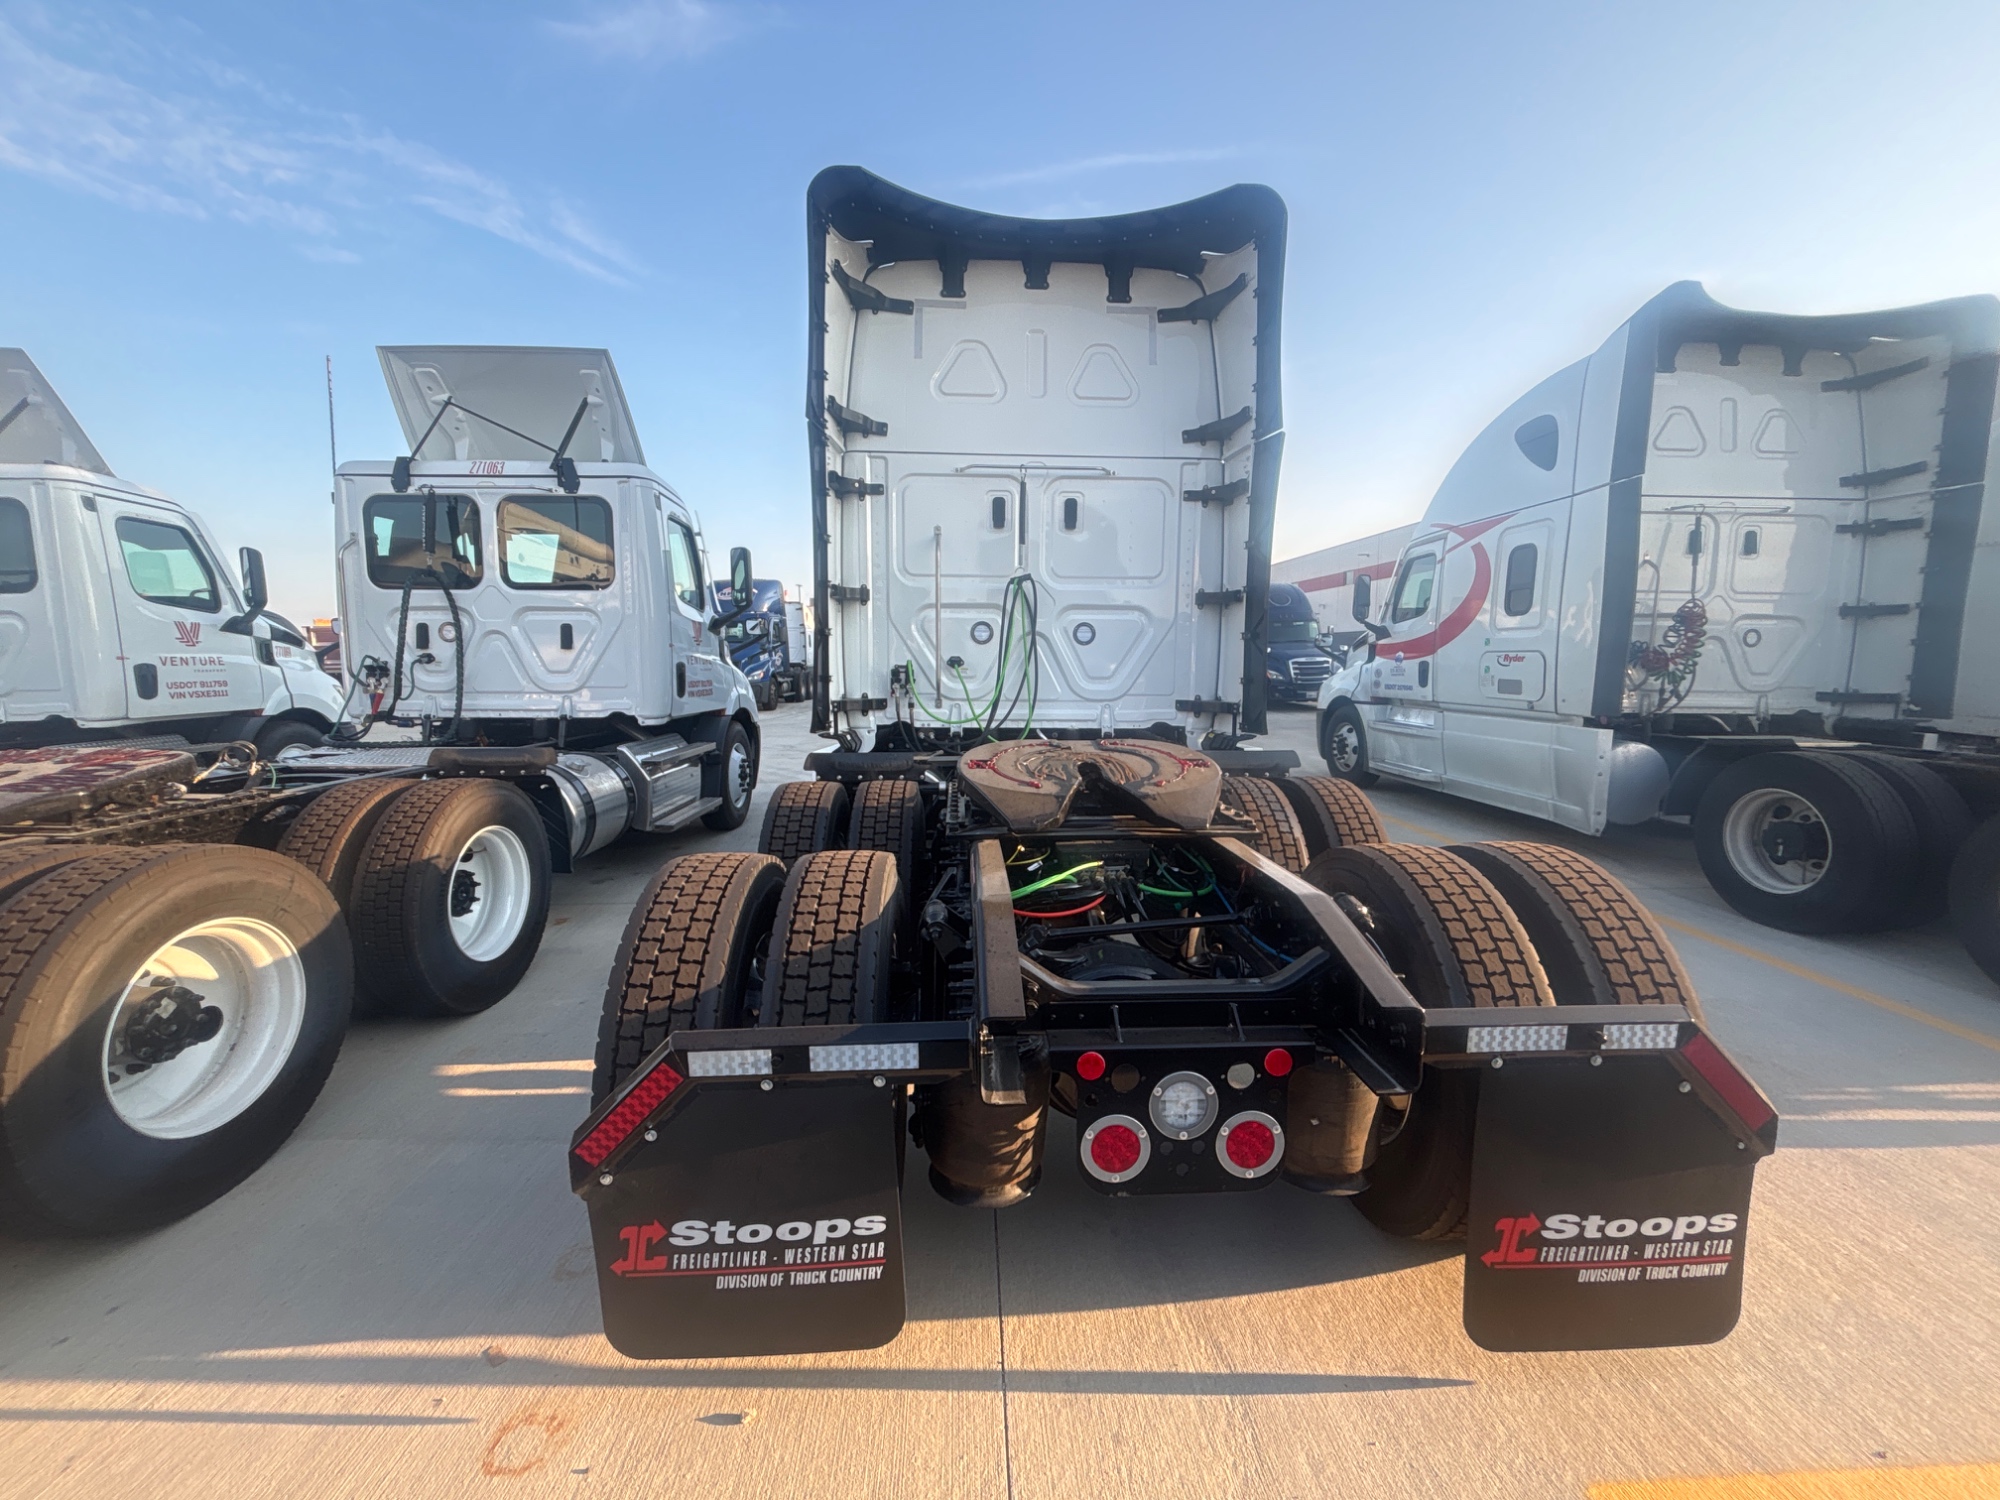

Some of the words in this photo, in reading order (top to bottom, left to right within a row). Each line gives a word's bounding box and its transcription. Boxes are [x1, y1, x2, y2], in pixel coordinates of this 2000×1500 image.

[469, 460, 505, 474] 271063
[158, 656, 226, 667] VENTURE
[1503, 654, 1526, 664] Ryder
[166, 681, 198, 690] USDOT
[200, 680, 229, 688] 911759
[168, 691, 187, 699] VIN
[187, 690, 229, 699] VSXE3111
[668, 1215, 887, 1246] Stoops
[1540, 1213, 1738, 1240] Stoops
[673, 1250, 767, 1270] FREIGHTLINER
[784, 1244, 846, 1265] WESTERN
[851, 1241, 886, 1260] STAR
[1540, 1243, 1629, 1263] FREIGHTLINER
[1643, 1240, 1700, 1260] WESTERN
[1703, 1239, 1733, 1257] STAR
[716, 1273, 768, 1290] DIVISION
[770, 1272, 784, 1287] OF
[789, 1270, 827, 1286] TRUCK
[830, 1265, 884, 1283] COUNTRY
[1577, 1267, 1626, 1283] DIVISION
[1627, 1266, 1641, 1281] OF
[1645, 1265, 1680, 1281] TRUCK
[1681, 1262, 1729, 1278] COUNTRY
